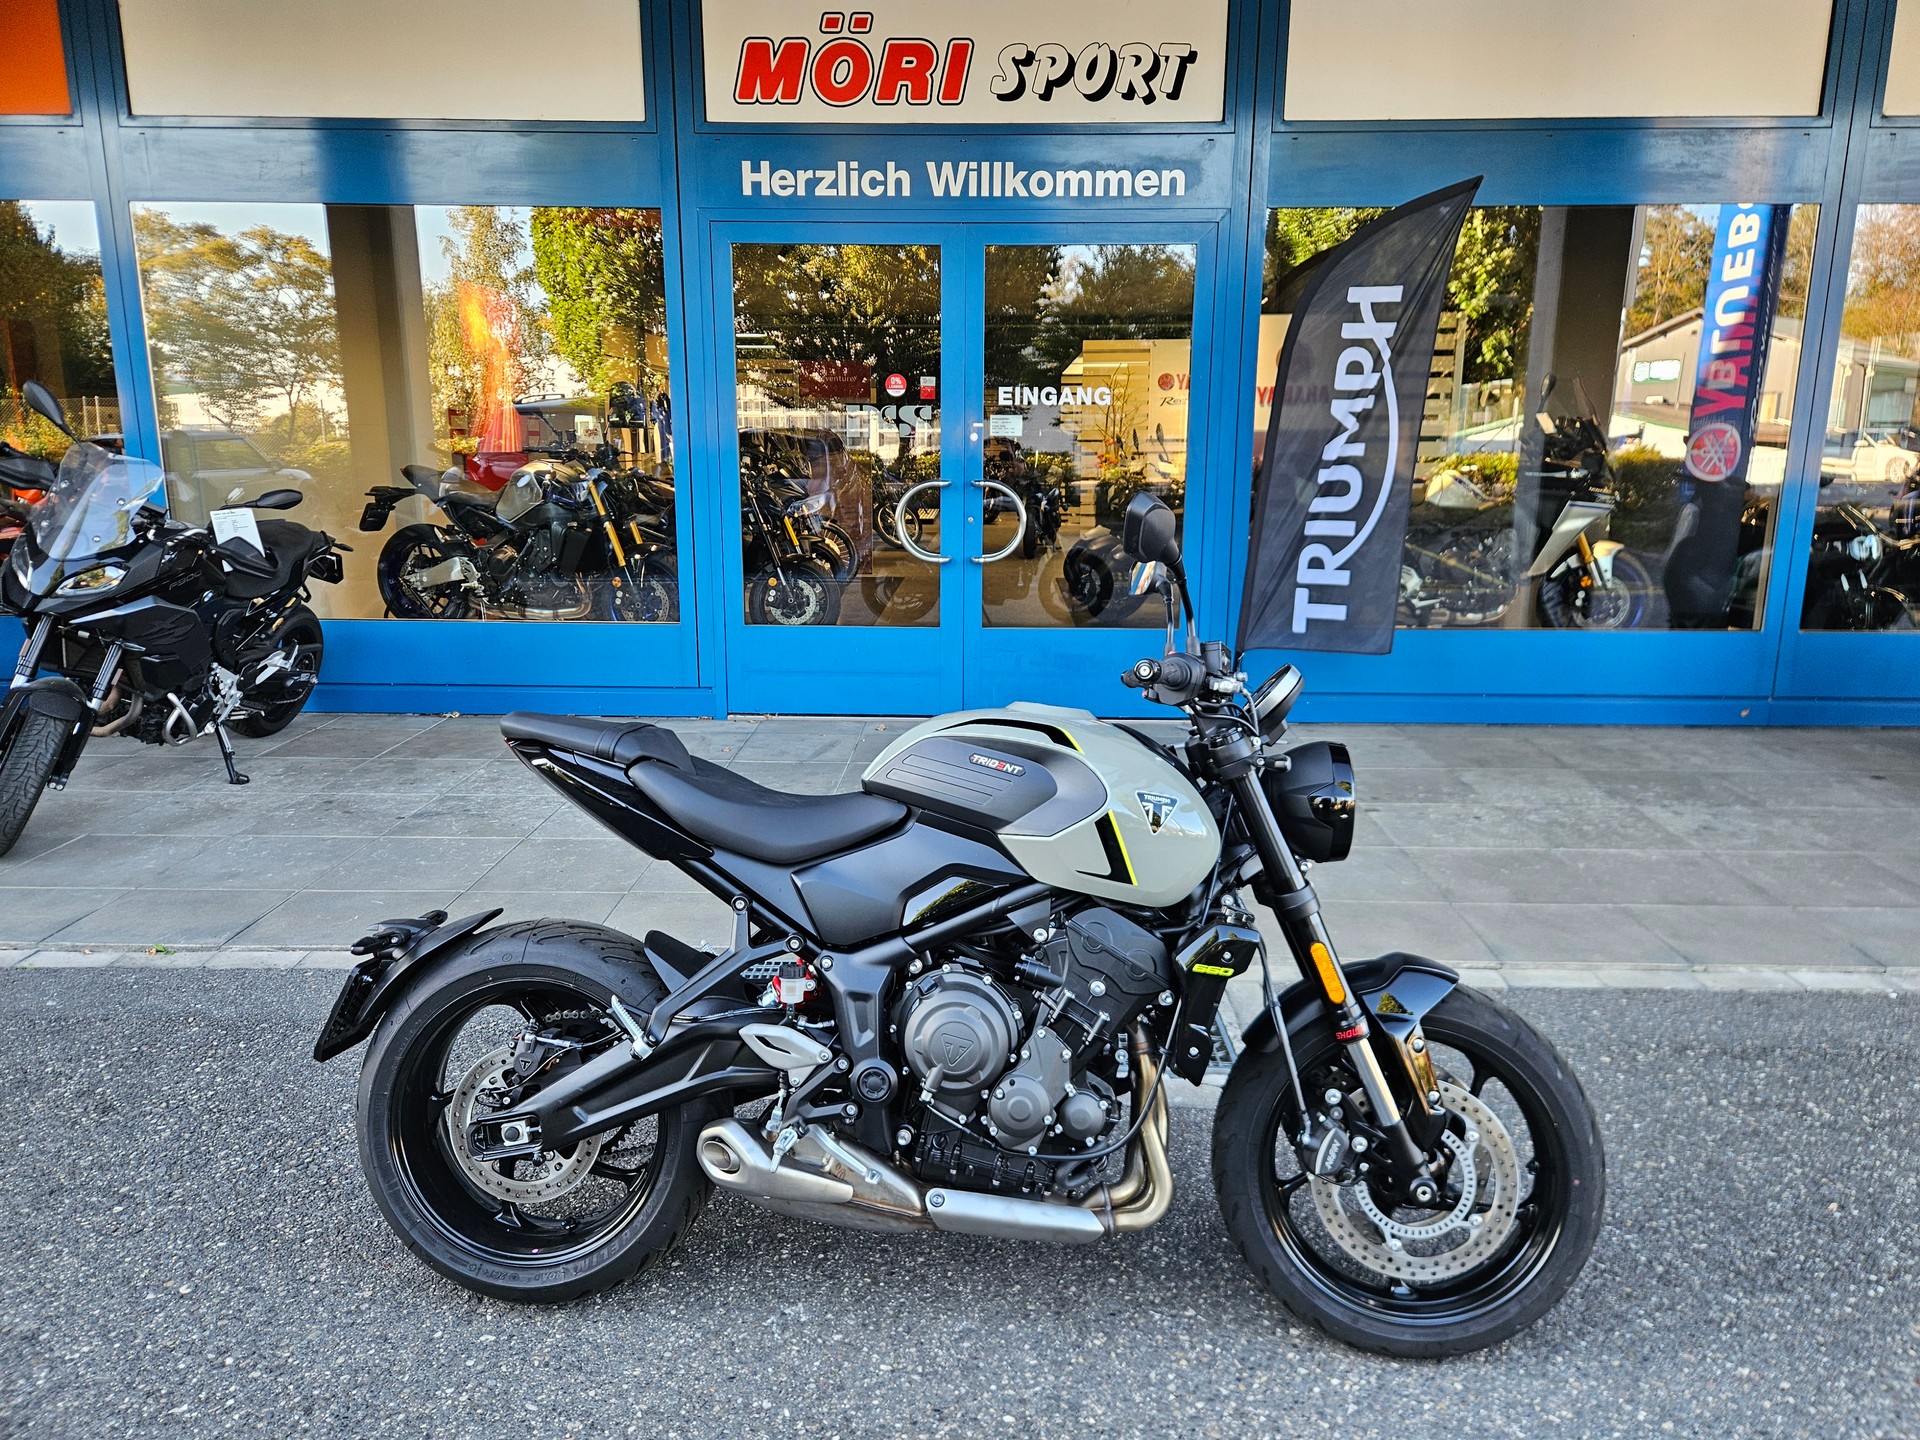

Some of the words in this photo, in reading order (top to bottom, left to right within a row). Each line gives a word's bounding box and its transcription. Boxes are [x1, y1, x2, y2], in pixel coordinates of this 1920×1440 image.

[733, 12, 974, 107] MÖRI
[989, 41, 1198, 105] SPORT
[741, 160, 910, 197] Herzlich
[926, 160, 1186, 197] Willkommen
[997, 386, 1112, 406] EINGANG
[1291, 284, 1404, 634] TRIUMPH
[971, 754, 1023, 774] TRIDENT
[1192, 963, 1235, 977] 660
